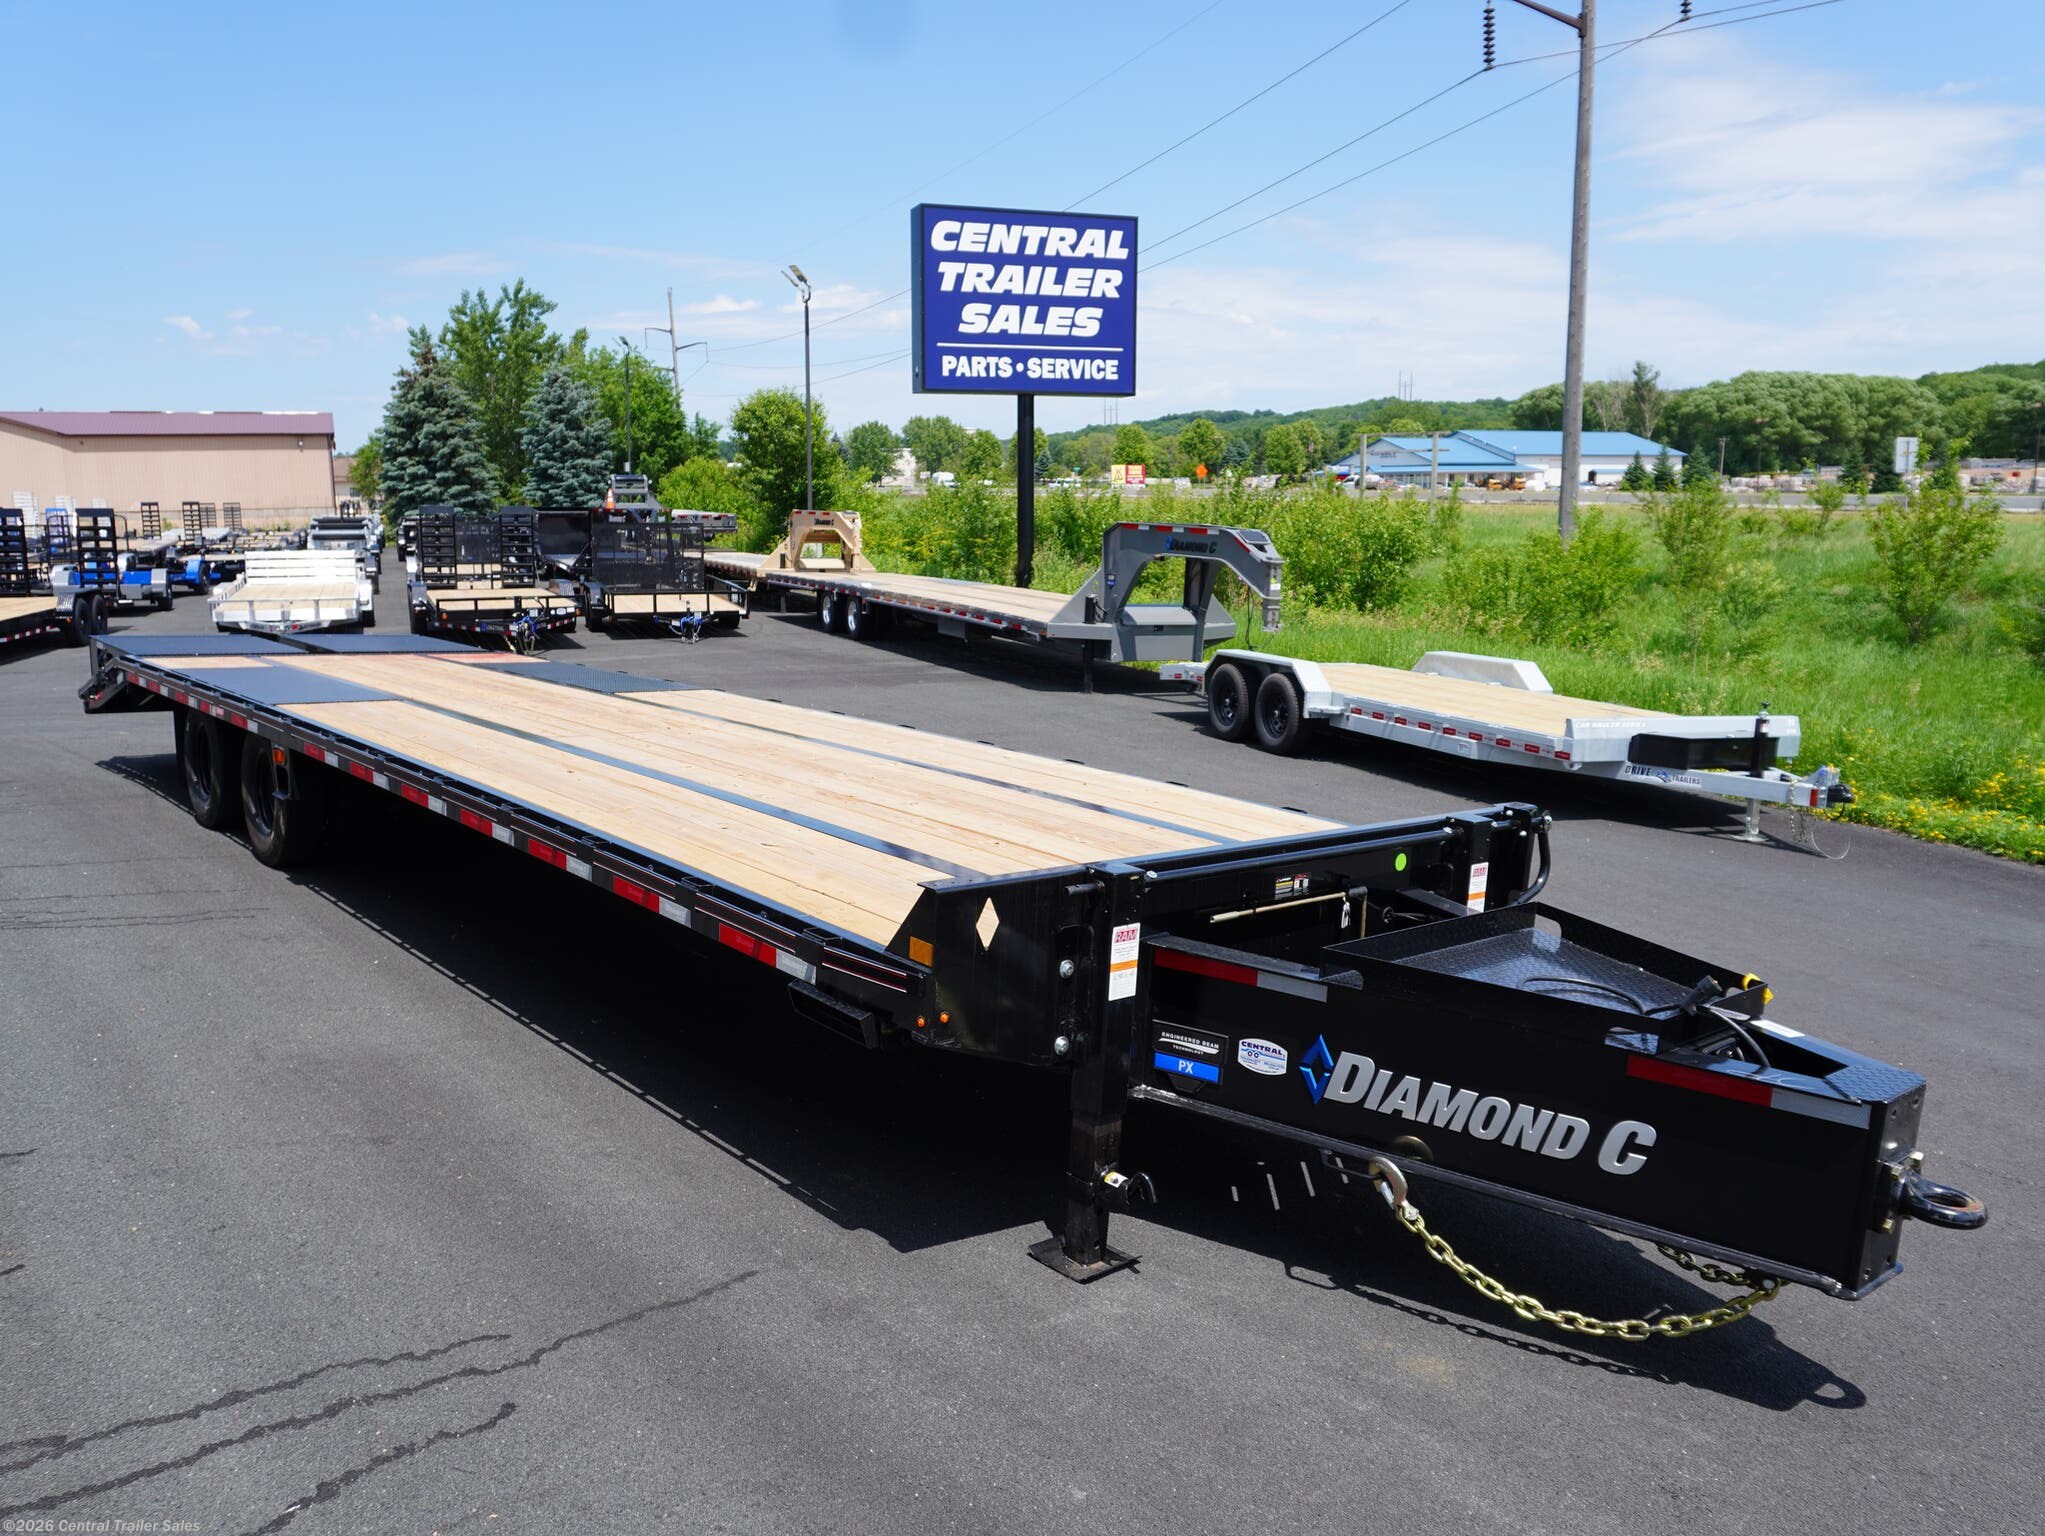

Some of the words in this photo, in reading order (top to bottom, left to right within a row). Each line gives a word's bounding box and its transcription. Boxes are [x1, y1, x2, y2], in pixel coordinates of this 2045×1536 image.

[931, 220, 1129, 259] CENTRAL
[937, 261, 1123, 298] TRAILER
[958, 302, 1104, 337] SALES
[942, 355, 1013, 378] PARTS
[1027, 357, 1119, 380] SERVICE
[1624, 765, 1652, 776] DRIVE
[1672, 774, 1700, 785] TRAILERS
[1114, 929, 1137, 944] RAM
[1161, 1031, 1200, 1045] ENGINEERED
[1202, 1040, 1219, 1049] BEAM
[1241, 1041, 1283, 1056] CENTRAL
[1172, 1044, 1204, 1055] TECHNOLOGY
[1178, 1059, 1194, 1075] PX
[1323, 1050, 1591, 1160] DIAMOND
[1598, 1120, 1657, 1175] C
